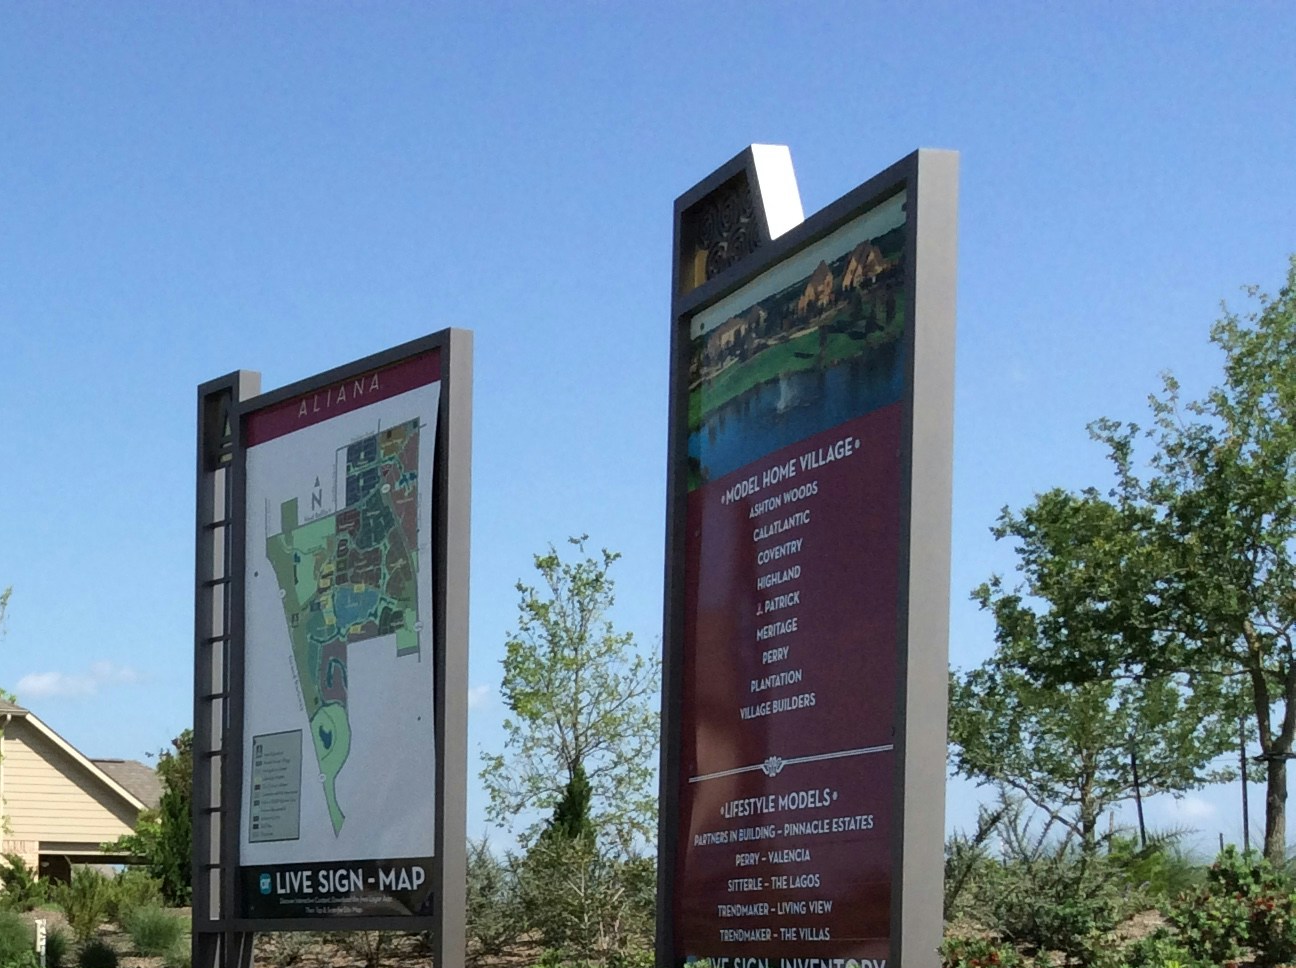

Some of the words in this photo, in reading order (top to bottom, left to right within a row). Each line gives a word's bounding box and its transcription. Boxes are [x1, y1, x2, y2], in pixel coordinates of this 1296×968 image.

[297, 372, 380, 418] ALIANA
[725, 476, 760, 505] MODEL
[762, 458, 797, 489] HOME
[799, 437, 853, 471] VILLAGE
[311, 488, 322, 511] N
[749, 494, 781, 519] ASHTON
[783, 481, 818, 504] WOODS
[753, 510, 810, 542] CALATLANTIC
[757, 538, 803, 565] COVENTRY
[757, 565, 801, 591] HIGHLAND
[764, 591, 800, 613] PATRICK
[756, 617, 798, 641] MERITAGE
[762, 646, 789, 665] PERRY
[750, 669, 802, 693] PLANTATION
[739, 701, 771, 721] VILLAGE
[772, 692, 816, 713] BUILDERS
[724, 794, 775, 818] LIFESTYLE
[778, 788, 830, 811] MODELS
[693, 830, 728, 847] PARTNERS
[729, 830, 737, 842] IN
[738, 825, 775, 841] BUILDING
[783, 819, 830, 837] PINNACLE
[832, 815, 874, 832] ESTATES
[735, 852, 759, 867] PERRY
[768, 848, 810, 863] VALENCIA
[276, 870, 313, 894] LIVE
[318, 868, 364, 893] SIGN
[378, 866, 425, 891] MAP
[727, 877, 763, 892] SITTERLE
[771, 875, 788, 889] THE
[789, 874, 820, 888] LAGOS
[718, 903, 769, 917] TRENDMAKER
[777, 901, 807, 916] LIVING
[808, 900, 833, 914] VIEW
[720, 928, 771, 942] TRENDMAKER
[780, 928, 796, 941] THE
[799, 927, 831, 941] VILLAS
